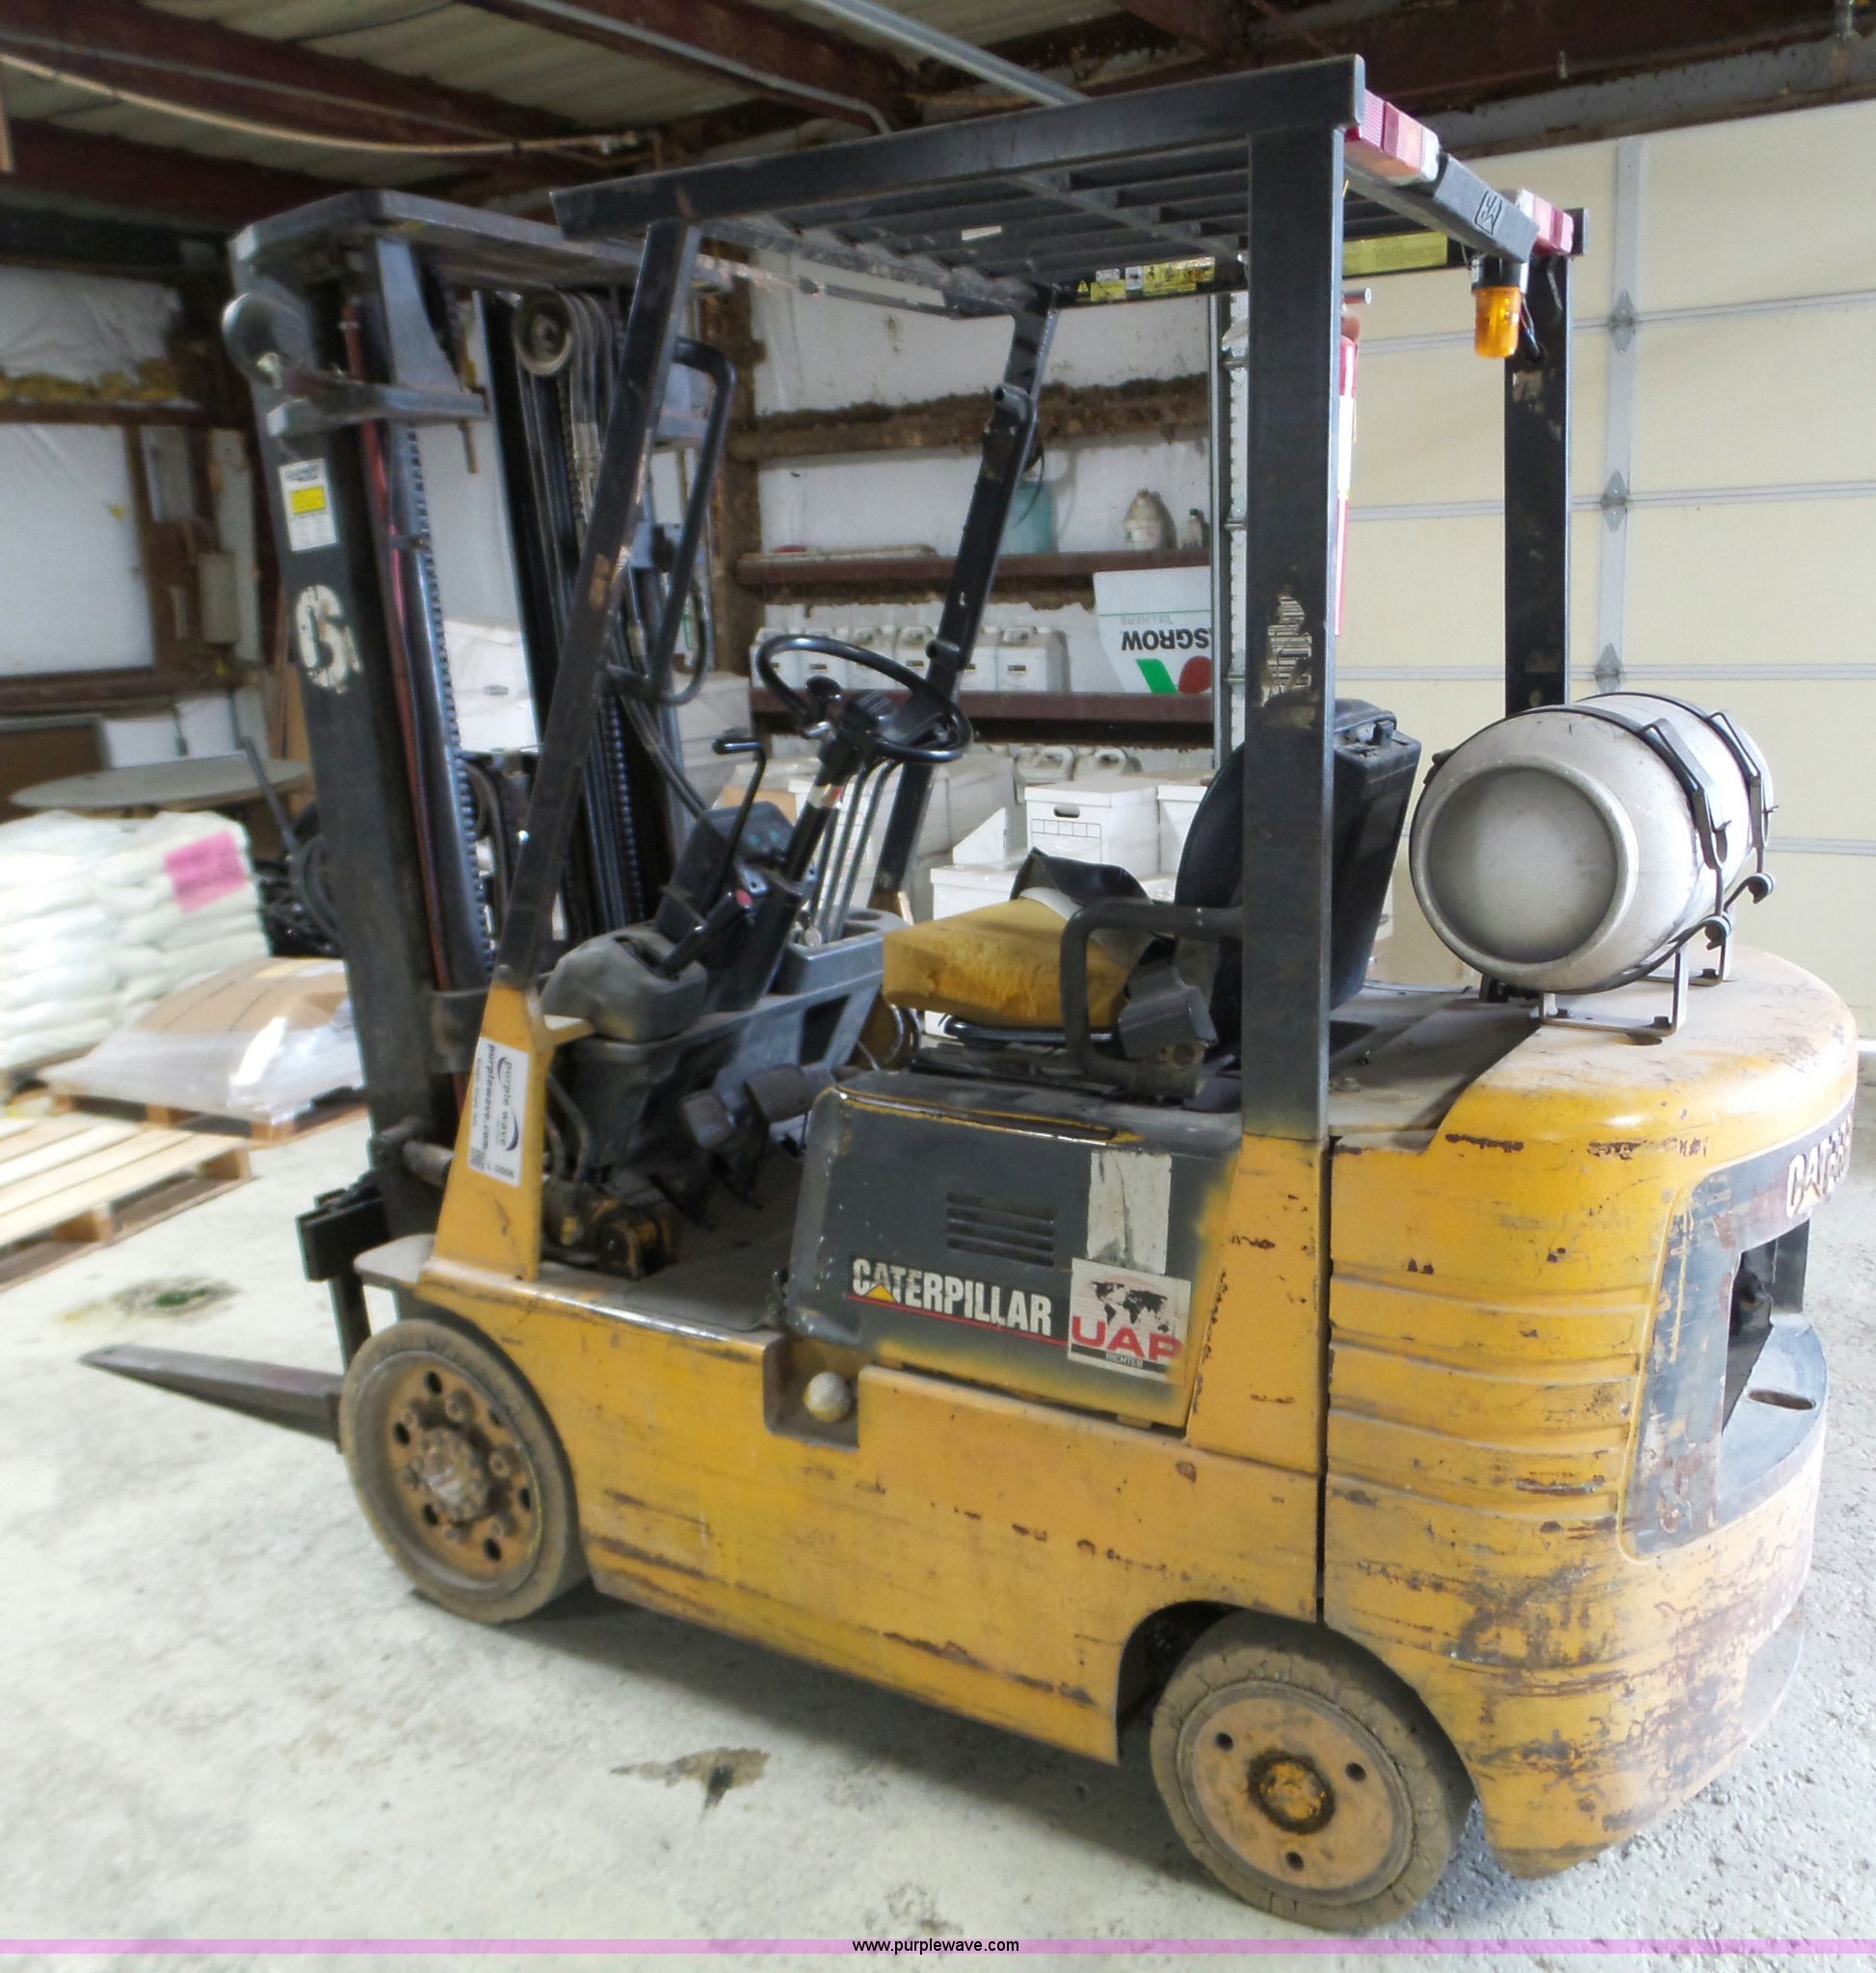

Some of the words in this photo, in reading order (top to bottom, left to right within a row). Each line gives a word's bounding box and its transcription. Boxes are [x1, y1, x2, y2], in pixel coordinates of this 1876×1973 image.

[1121, 626, 1212, 651] SGROW
[482, 1042, 495, 1150] purplewave.com
[502, 1060, 513, 1106] purple
[500, 1110, 509, 1146] wave
[852, 1257, 1052, 1337] CATERPILLAR
[1070, 1315, 1185, 1362] UAP
